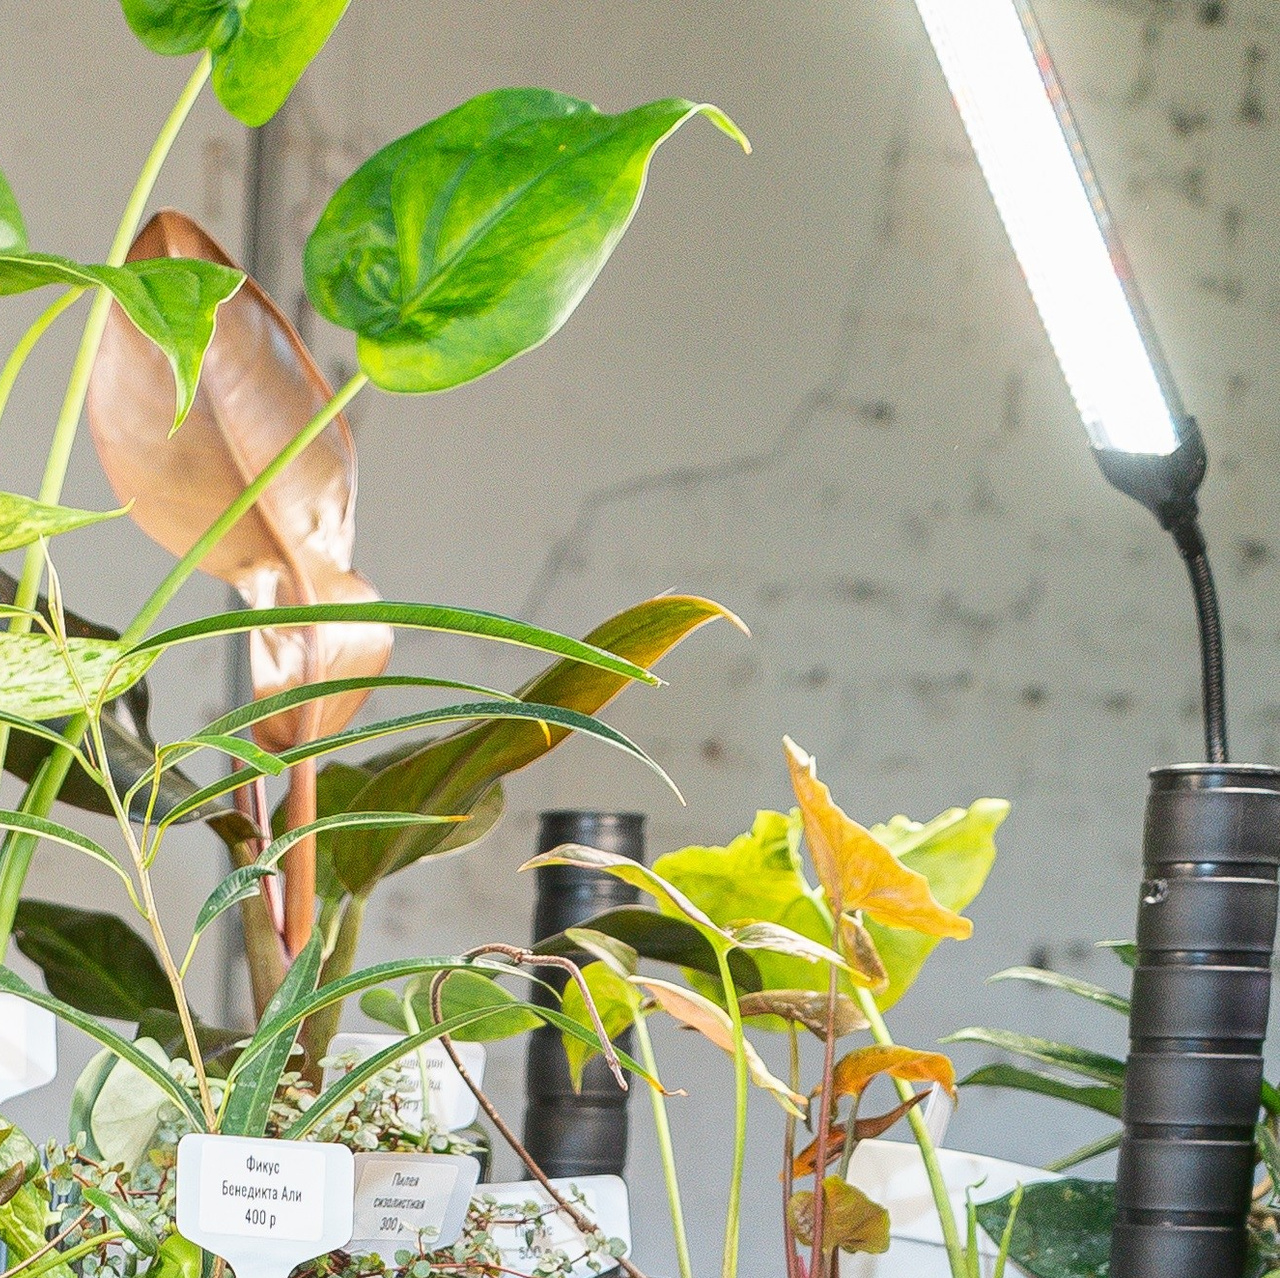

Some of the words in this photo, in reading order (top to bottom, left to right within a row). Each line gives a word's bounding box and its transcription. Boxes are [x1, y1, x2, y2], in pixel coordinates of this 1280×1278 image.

[246, 1155, 280, 1176] Фикус
[222, 1180, 278, 1201] Бенедикта
[280, 1187, 302, 1203] Али
[245, 1209, 266, 1226] 400
